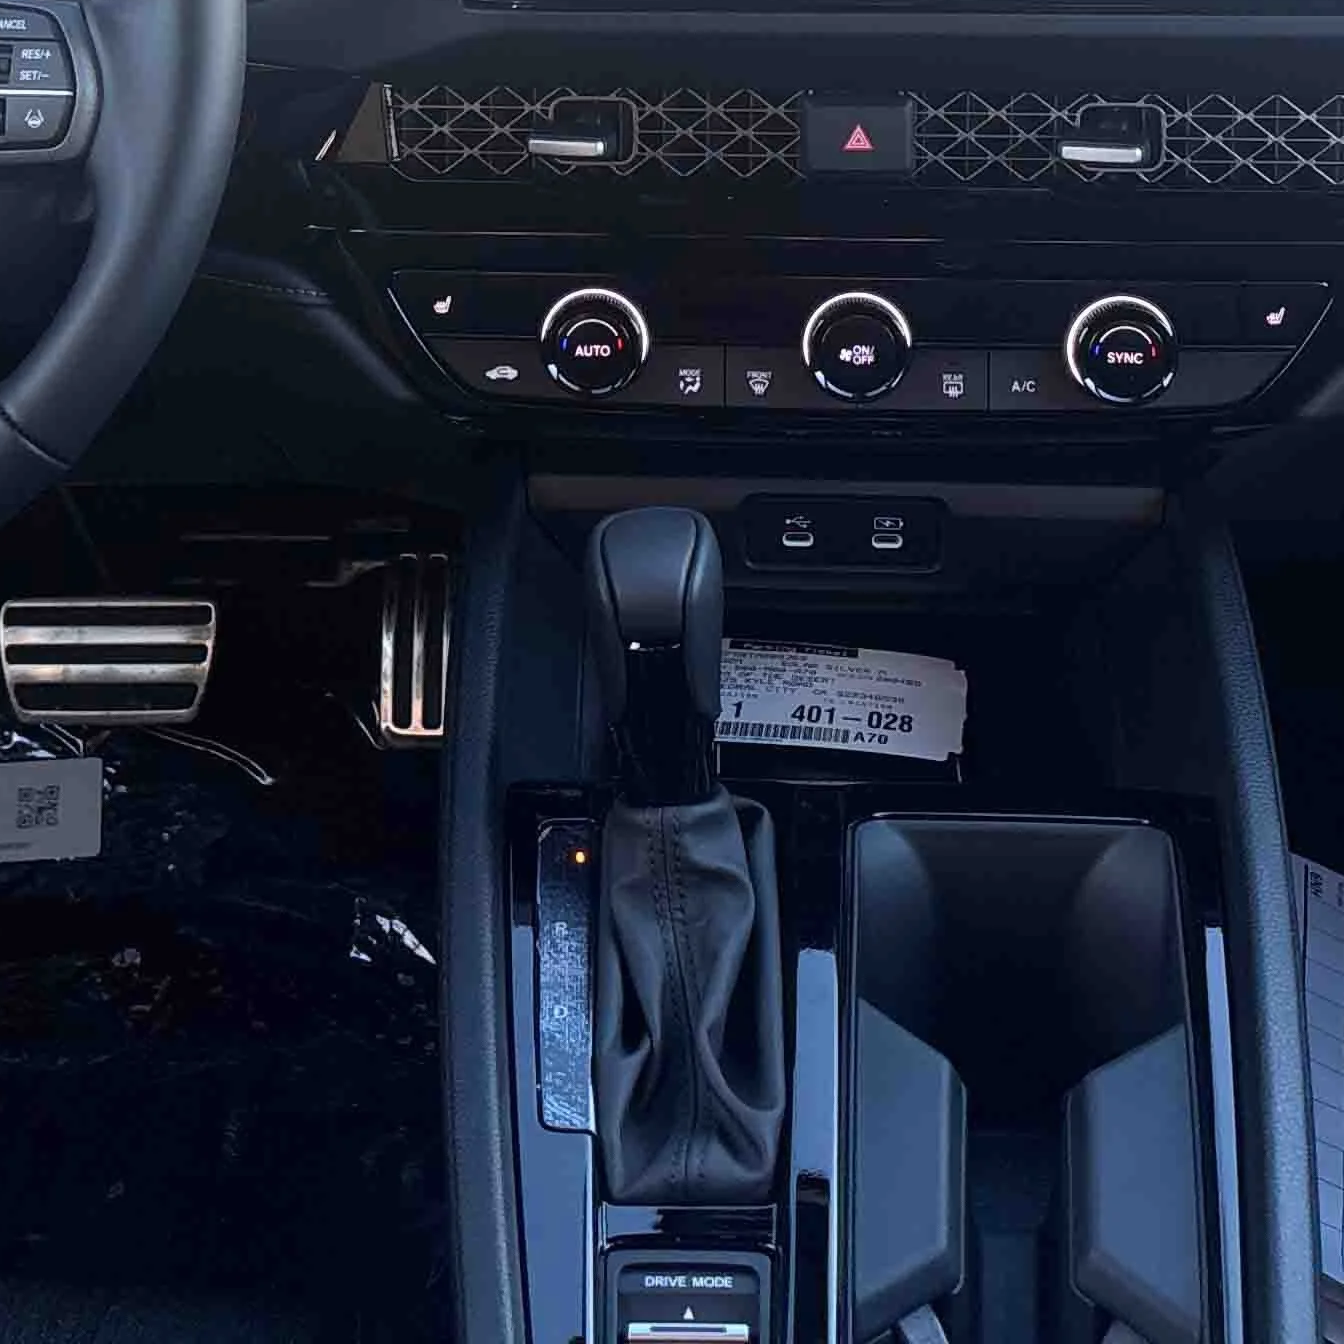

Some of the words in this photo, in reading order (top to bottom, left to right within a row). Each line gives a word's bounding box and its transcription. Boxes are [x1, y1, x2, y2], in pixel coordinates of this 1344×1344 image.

[575, 344, 611, 358] AUTO
[853, 355, 875, 365] OFF
[1106, 352, 1144, 365] SYNC
[679, 369, 702, 377] MODE
[1011, 380, 1036, 393] A/C
[645, 1276, 687, 1288] DRIVE
[692, 1276, 733, 1288] MODE
